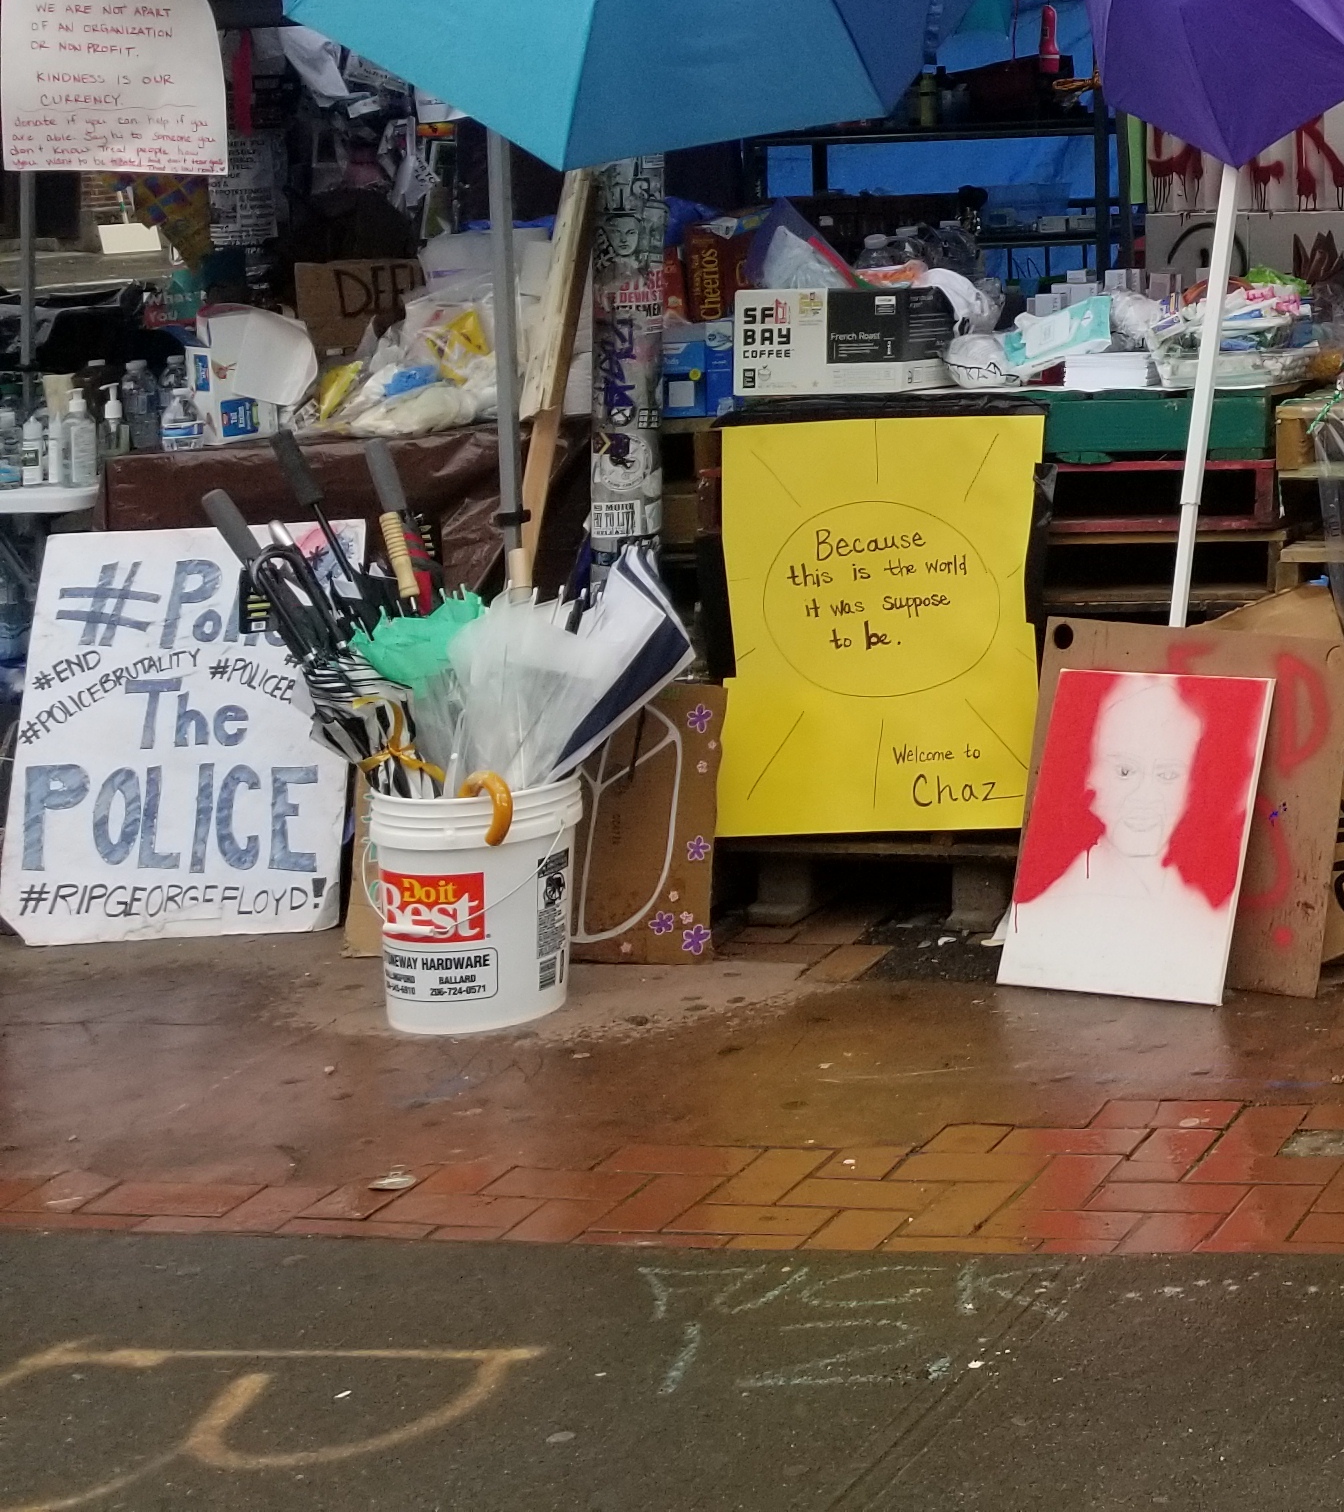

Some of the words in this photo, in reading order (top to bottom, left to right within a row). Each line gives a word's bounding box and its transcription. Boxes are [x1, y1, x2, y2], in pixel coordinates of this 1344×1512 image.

[36, 3, 55, 14] WE
[65, 5, 92, 15] ARE
[102, 5, 126, 15] NOT
[31, 21, 48, 32] OF
[58, 23, 74, 33] AN
[83, 24, 173, 39] ORGANIZATION
[31, 41, 49, 51] OR
[36, 72, 105, 84] KINDNESS
[117, 74, 131, 85] IS
[143, 74, 175, 85] OUR
[701, 248, 722, 320] Cheerios
[743, 307, 775, 325] SF
[743, 327, 791, 346] BAY
[830, 331, 857, 341] French
[858, 331, 881, 341] Roast
[743, 349, 791, 359] COFFEE
[814, 529, 927, 562] Because
[787, 563, 834, 589] this
[851, 564, 871, 582] is
[883, 560, 918, 578] the
[924, 554, 968, 577] world
[805, 598, 821, 618] it
[829, 597, 866, 618] was
[881, 592, 951, 621] suppose
[829, 629, 853, 650] to
[32, 649, 101, 692] #END
[124, 677, 249, 750] The
[892, 745, 955, 765] Welcome
[963, 743, 981, 760] to
[911, 774, 1024, 808] Chaz
[21, 762, 320, 874] POLICE
[402, 878, 431, 903] Do
[438, 880, 458, 903] it
[379, 878, 480, 939] Best
[421, 953, 491, 971] HARDWARE
[438, 974, 476, 984] BALLARD
[430, 984, 487, 996] 206-724-0571
[637, 1258, 1070, 1321] FUCK
